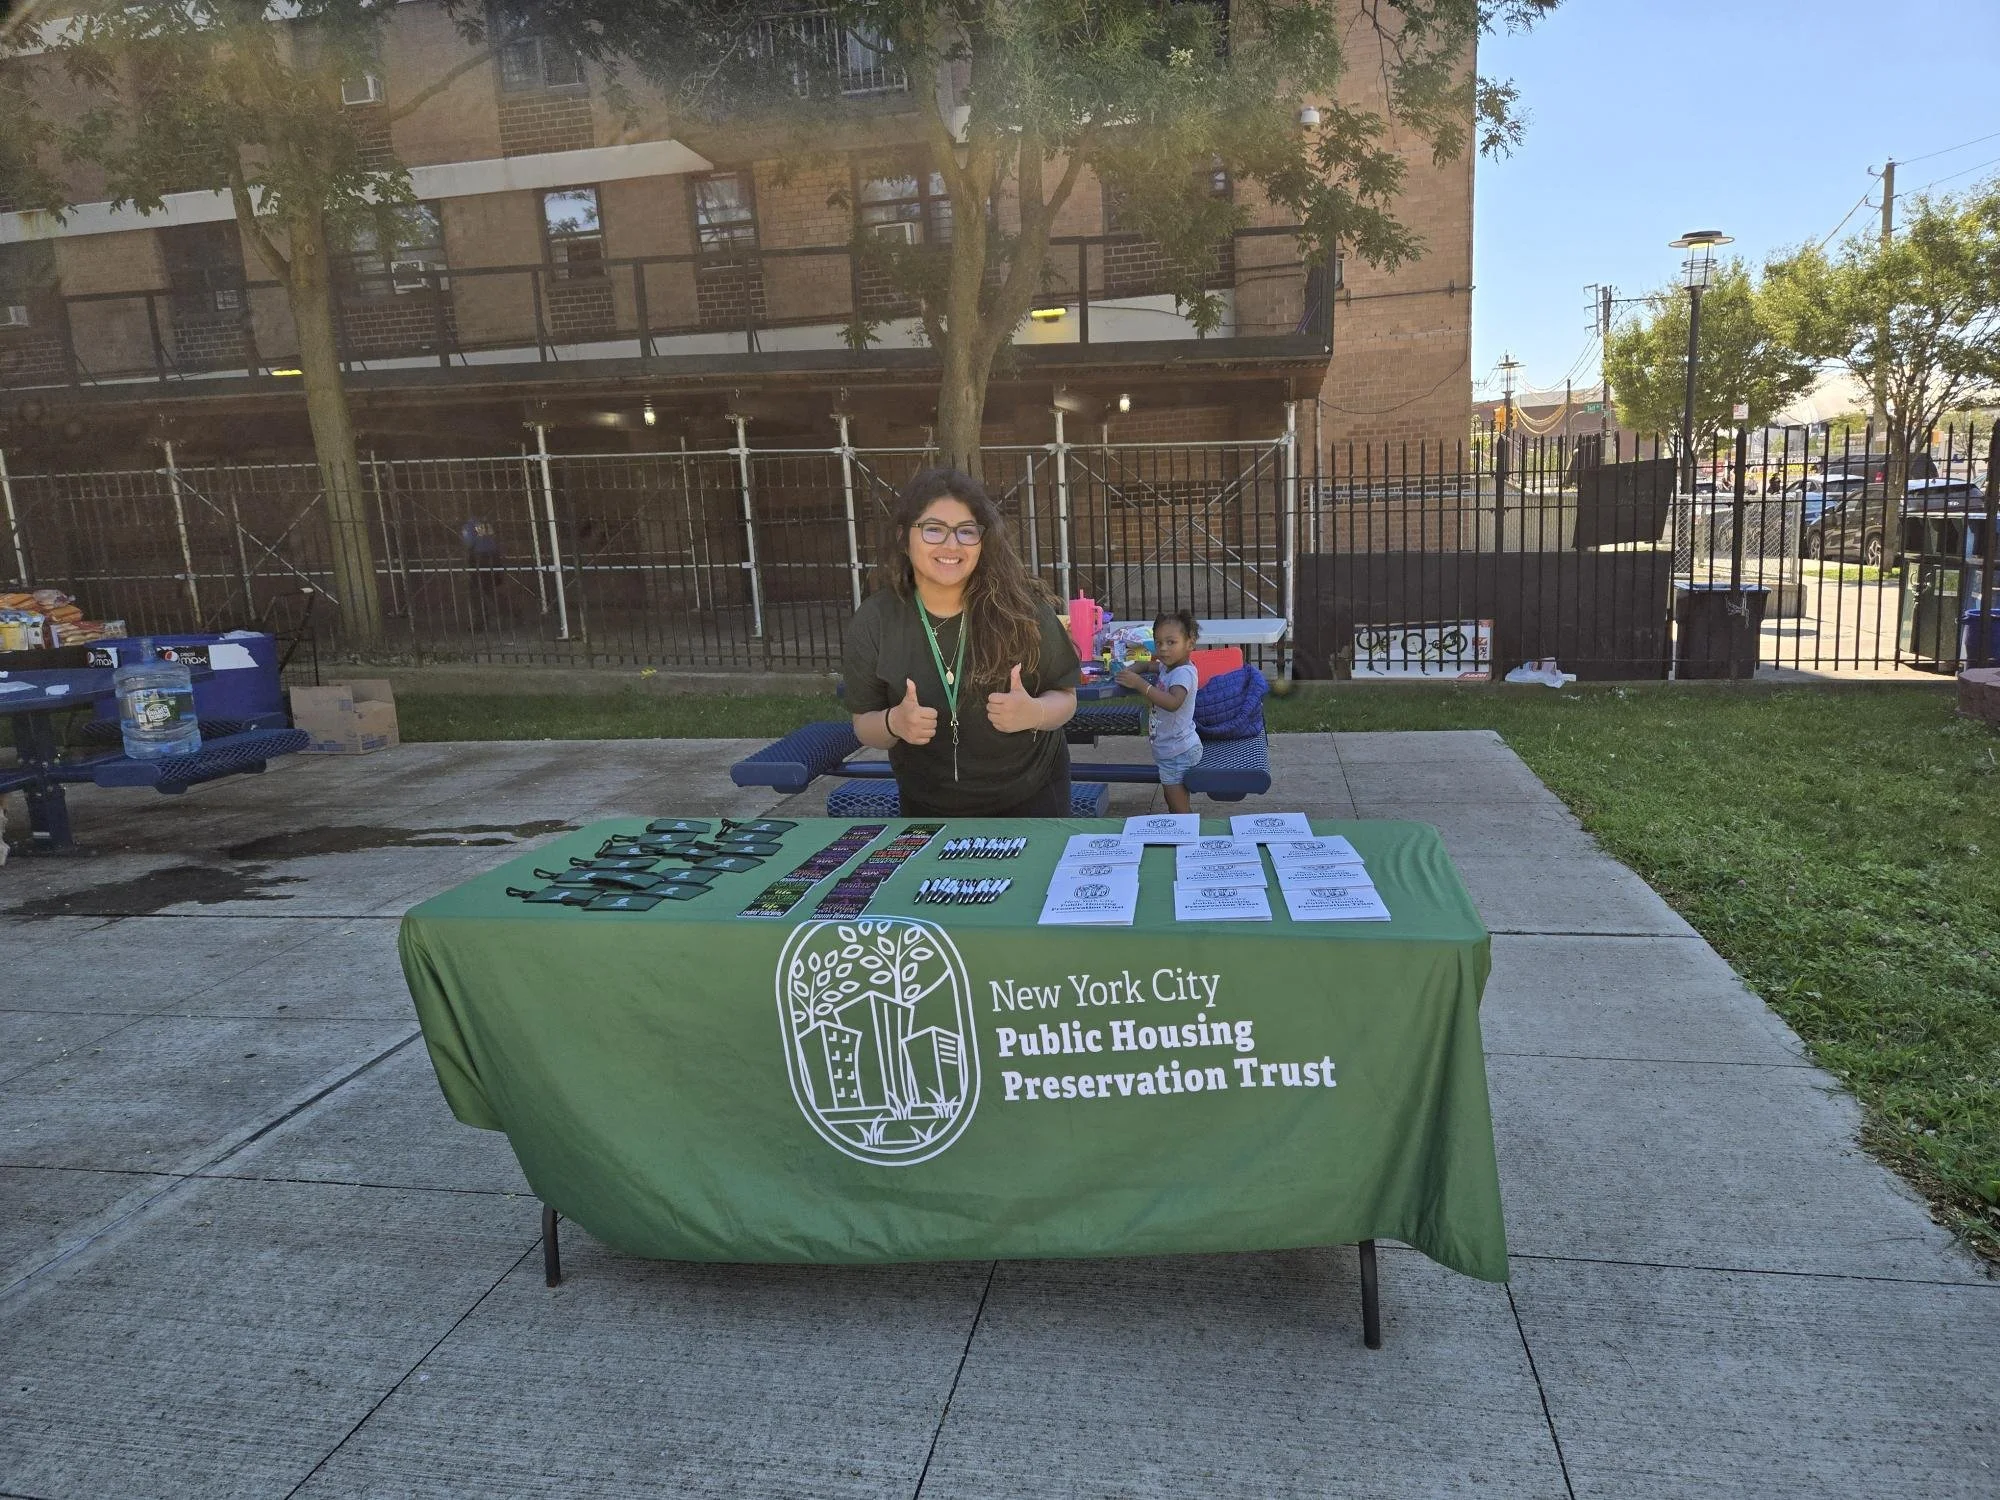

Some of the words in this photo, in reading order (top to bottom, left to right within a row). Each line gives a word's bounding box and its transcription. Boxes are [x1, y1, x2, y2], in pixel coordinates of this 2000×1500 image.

[180, 656, 208, 665] max
[989, 979, 1061, 1012] New
[1068, 970, 1146, 1007] York
[1151, 967, 1220, 1008] City
[995, 1020, 1103, 1057] Public
[1109, 1013, 1255, 1052] Housing
[1002, 1060, 1228, 1101] Preservation
[1233, 1055, 1337, 1088] Trust
